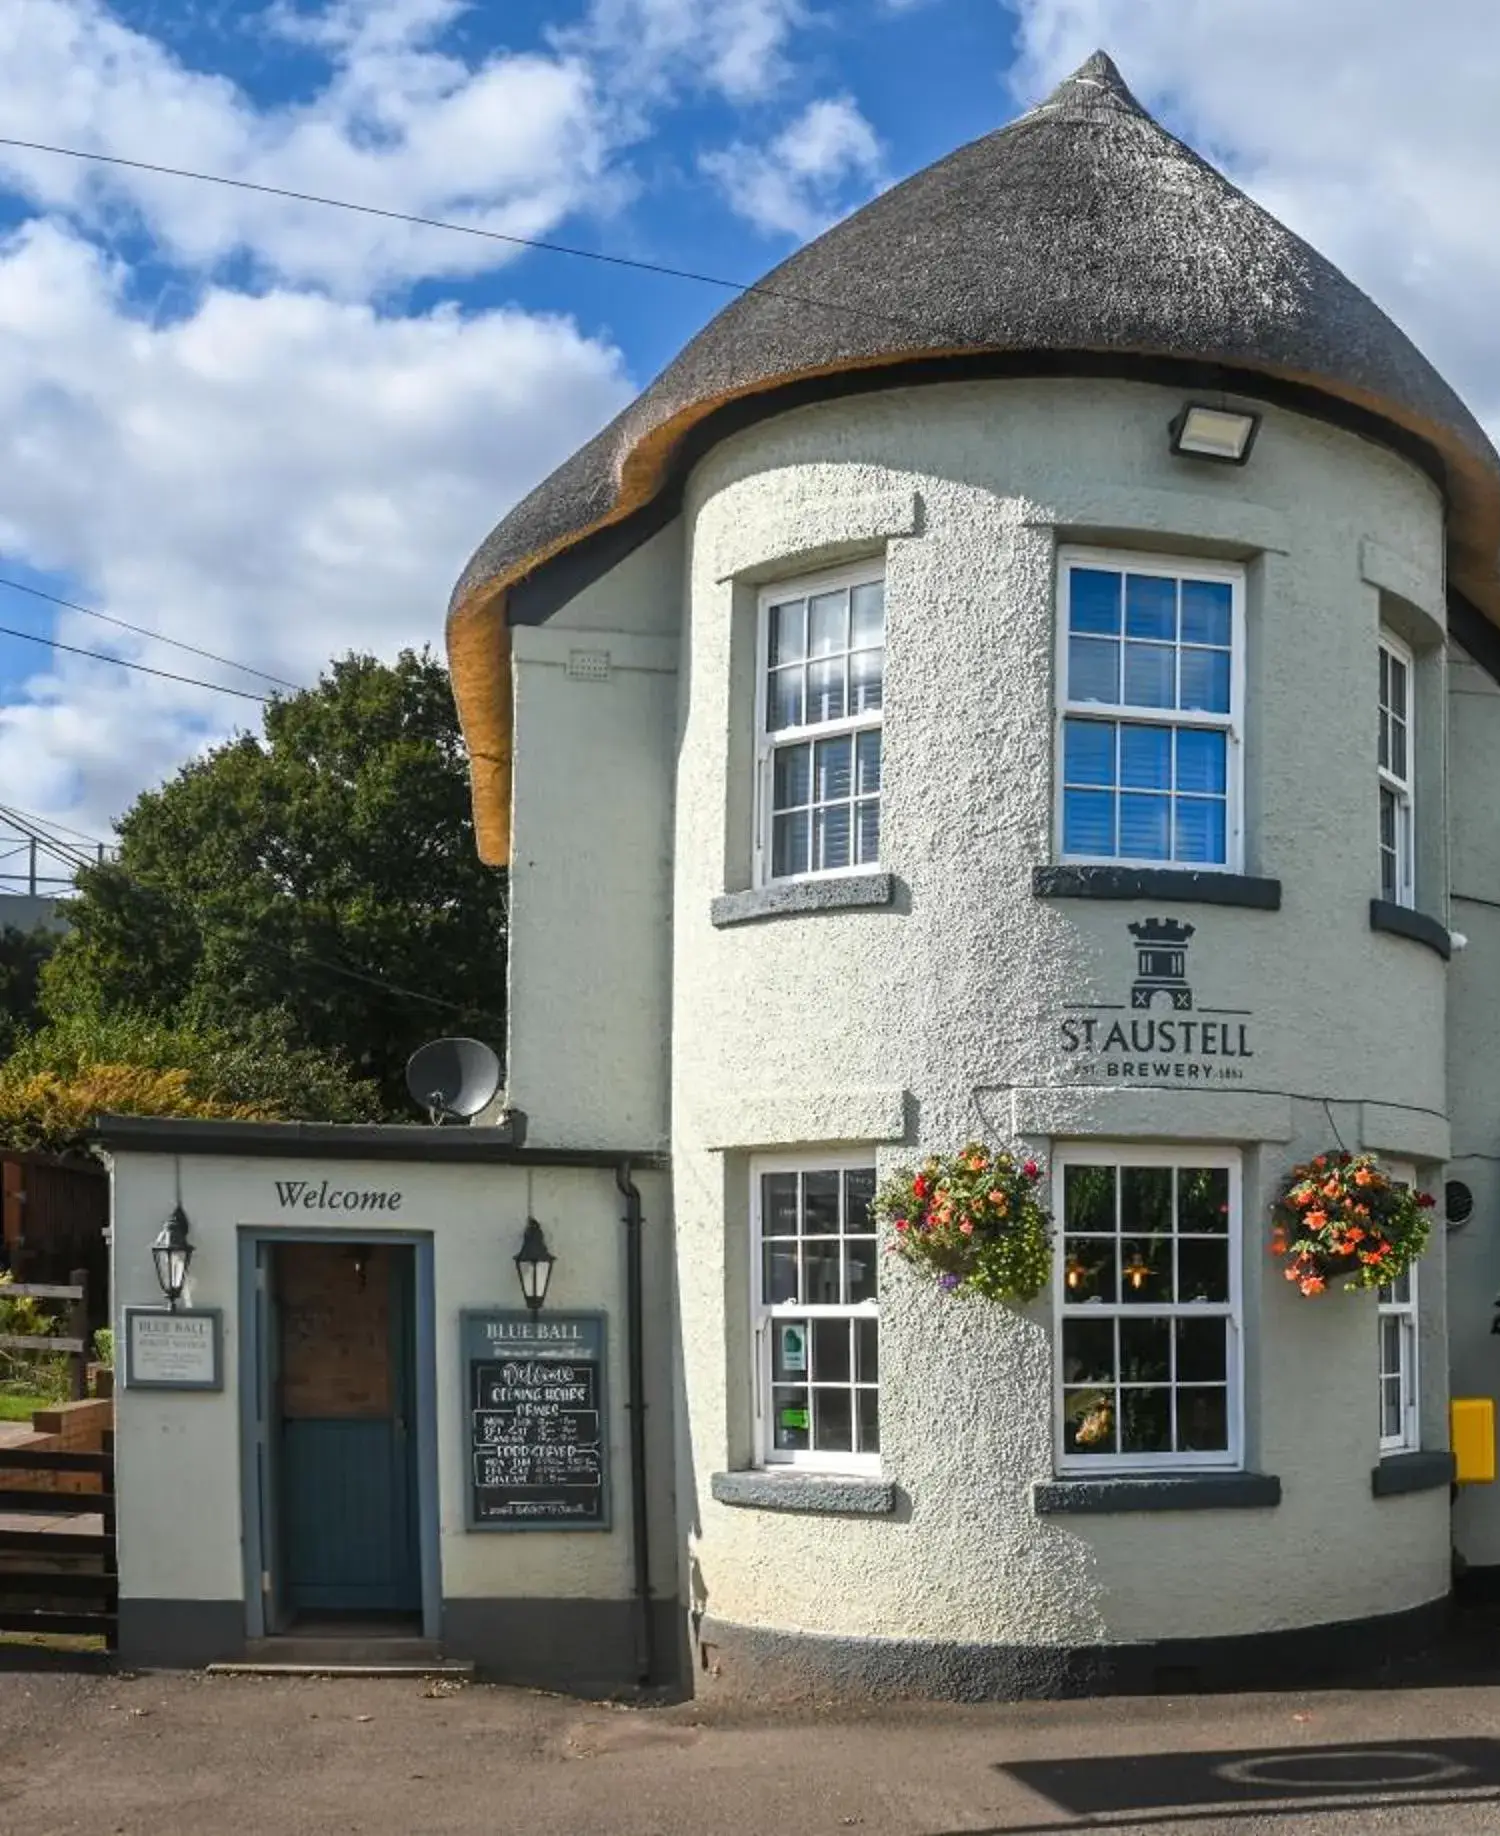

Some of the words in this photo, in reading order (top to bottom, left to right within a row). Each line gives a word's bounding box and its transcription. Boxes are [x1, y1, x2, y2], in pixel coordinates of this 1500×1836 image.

[1061, 1018, 1098, 1052] ST
[1101, 1019, 1254, 1057] AUSTELL
[1107, 1062, 1213, 1079] BREWERY
[274, 1180, 402, 1211] Welcome
[485, 1323, 535, 1339] BLUE
[537, 1323, 584, 1339] BALL
